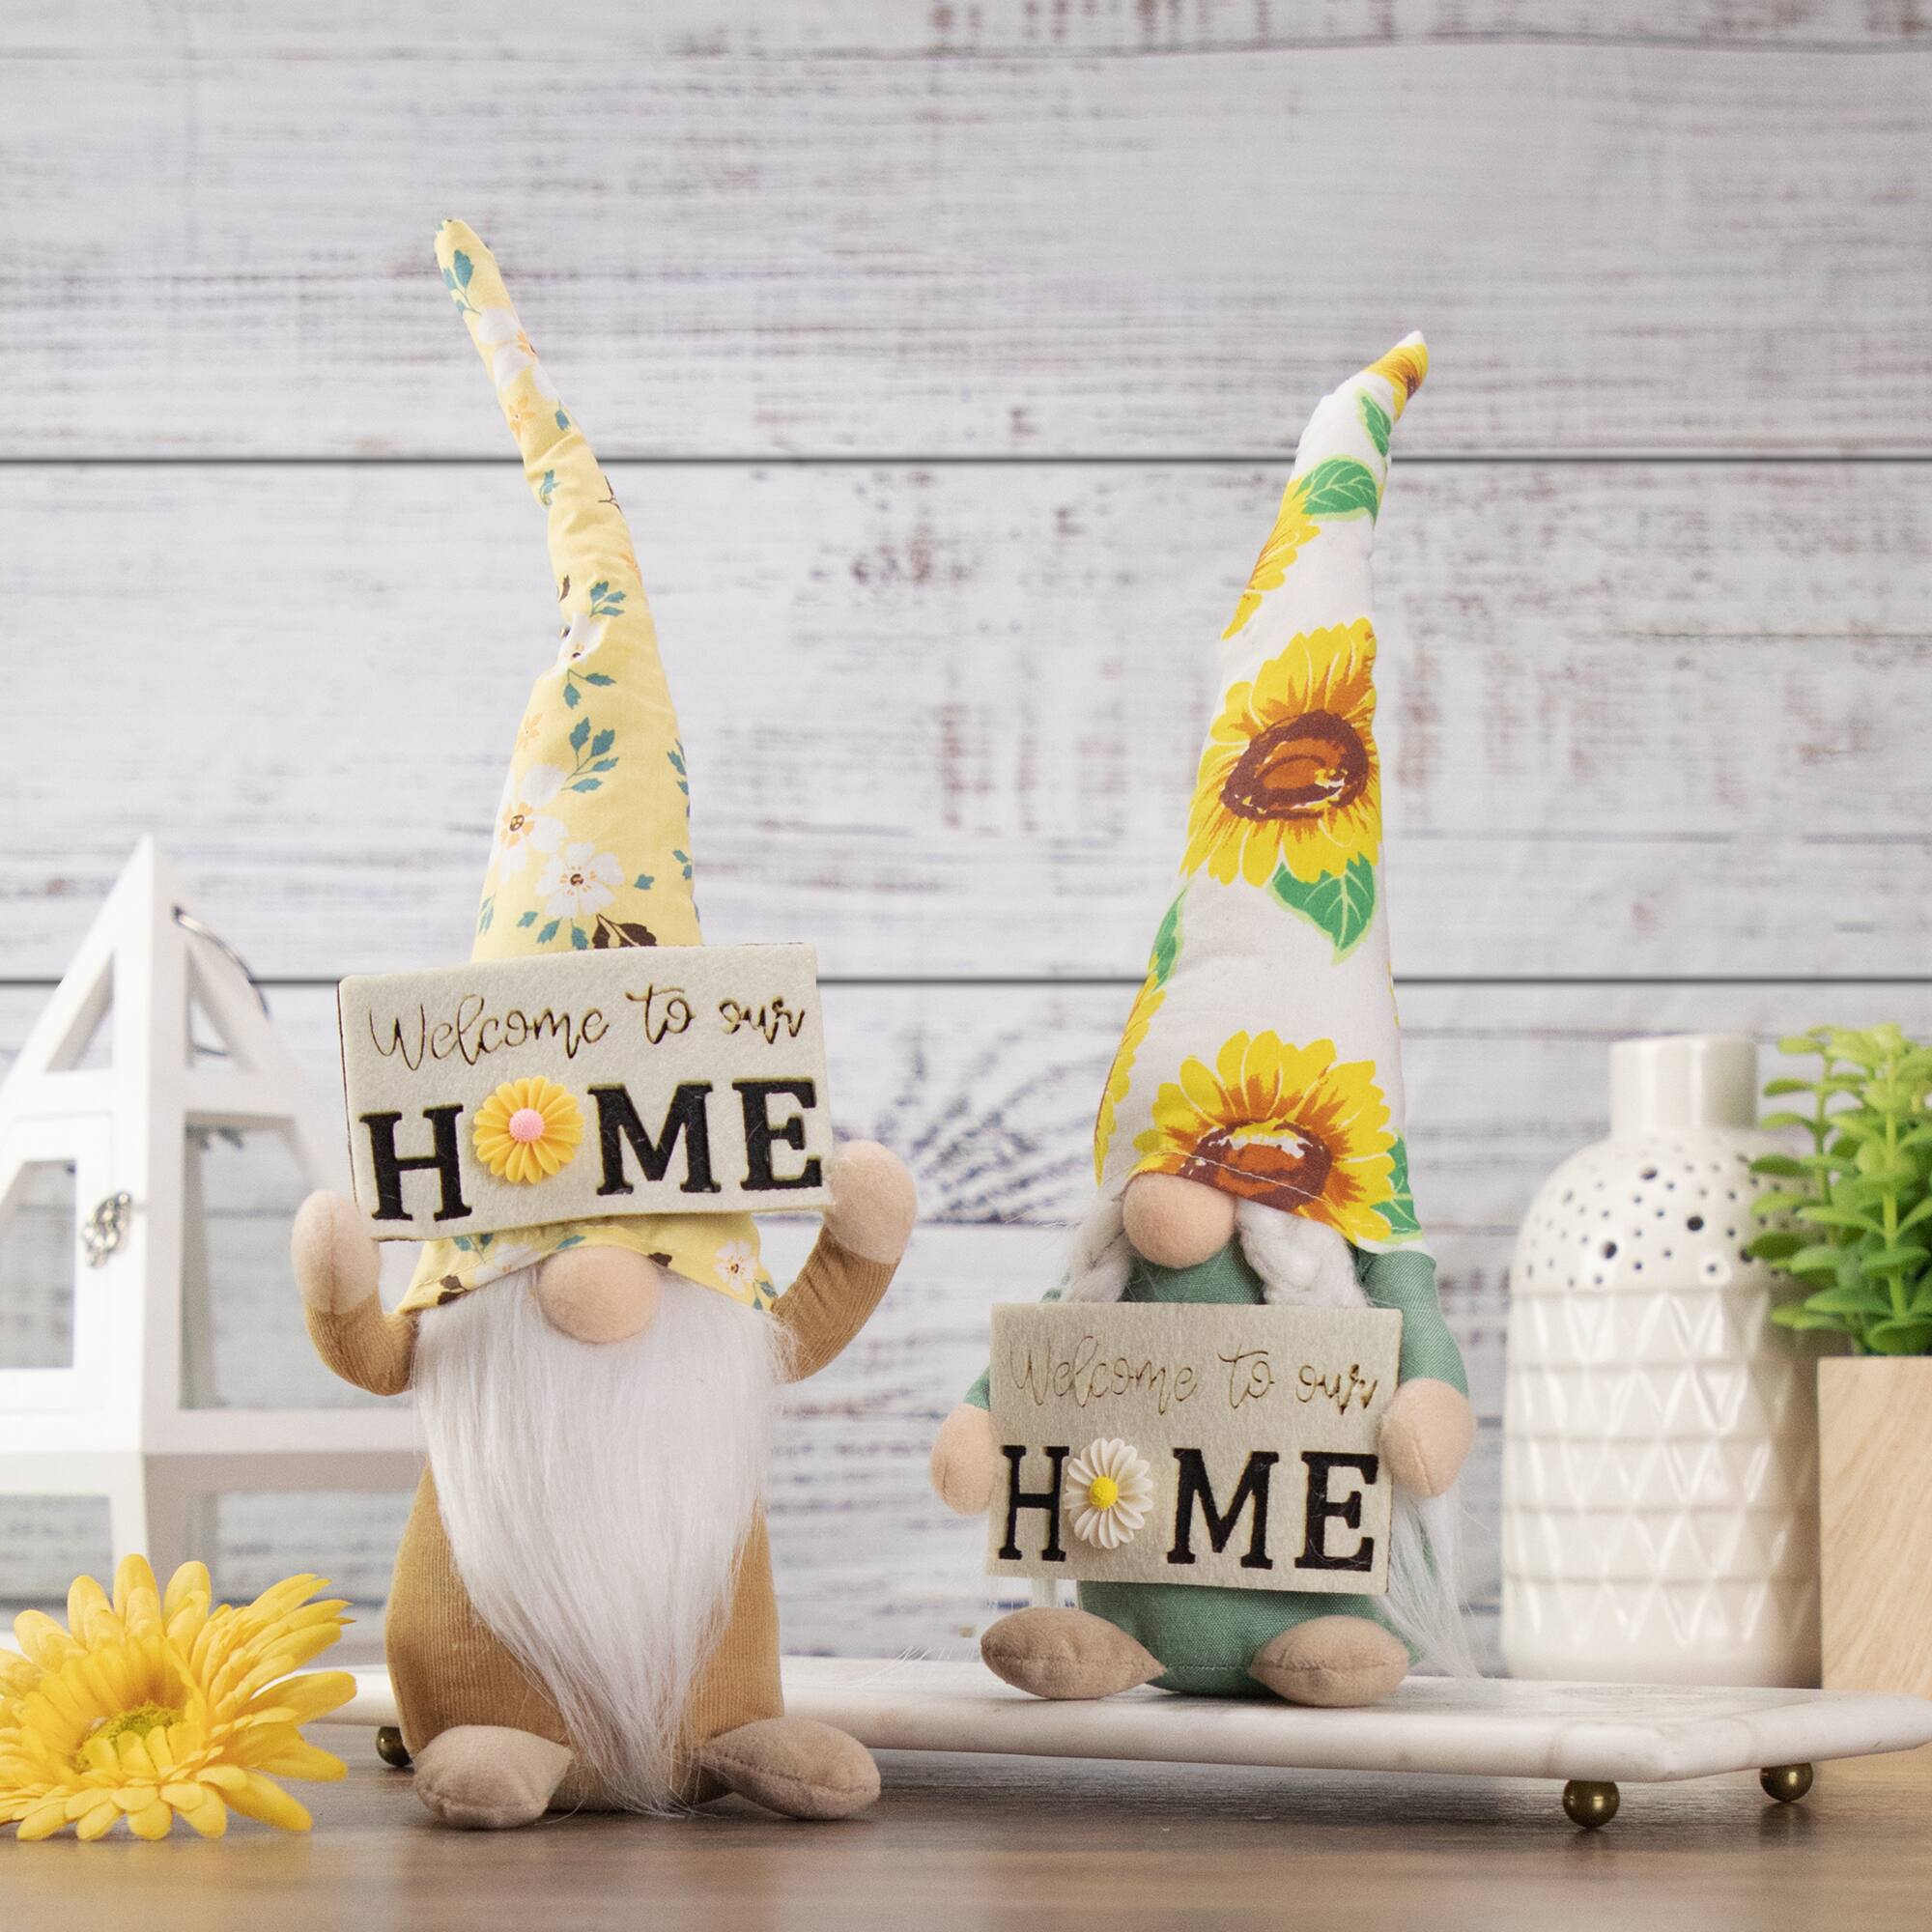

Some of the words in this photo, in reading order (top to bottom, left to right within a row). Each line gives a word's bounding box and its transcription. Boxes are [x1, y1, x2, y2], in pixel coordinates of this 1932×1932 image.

[369, 994, 610, 1071] Welcome
[625, 983, 696, 1045] to
[719, 996, 806, 1044] our
[1009, 1335, 1197, 1416] Welcome
[1217, 1344, 1276, 1409] to
[1295, 1363, 1378, 1415] our
